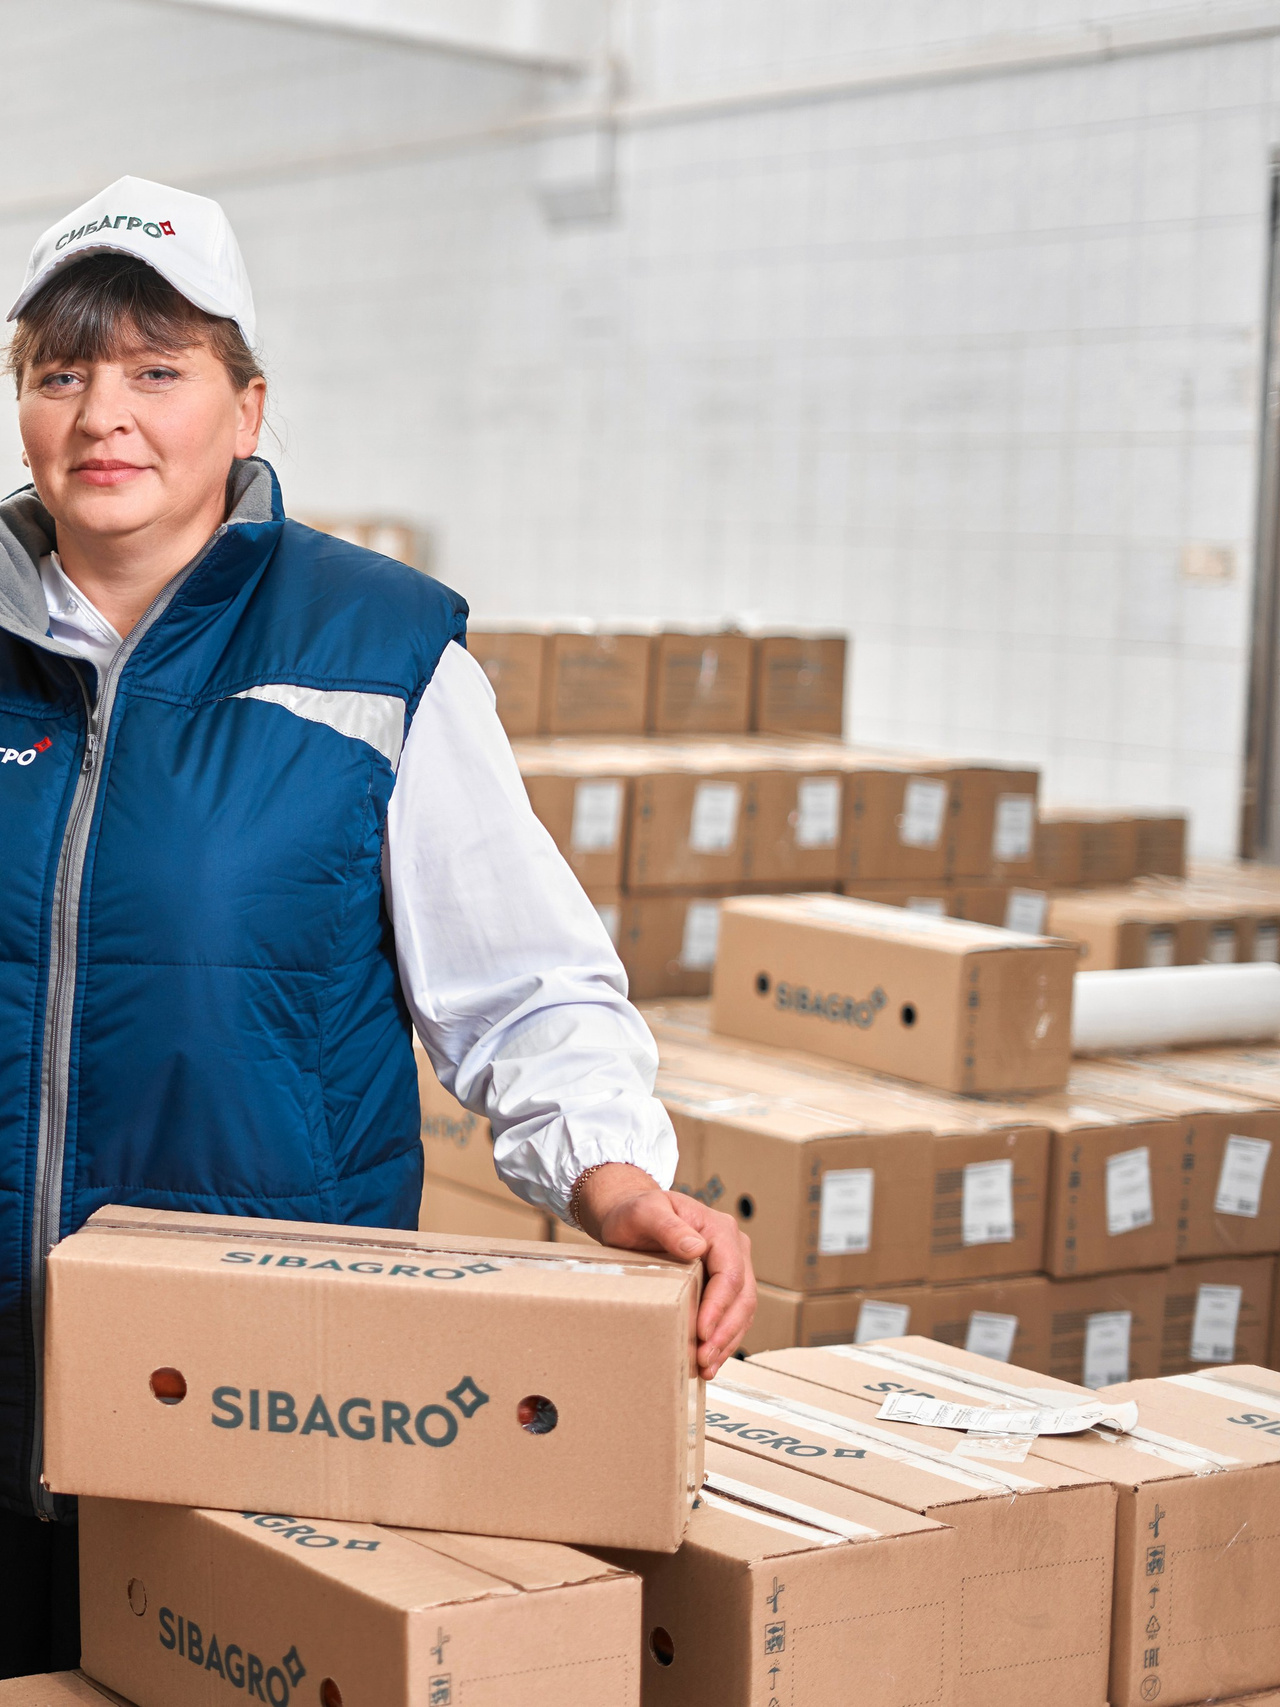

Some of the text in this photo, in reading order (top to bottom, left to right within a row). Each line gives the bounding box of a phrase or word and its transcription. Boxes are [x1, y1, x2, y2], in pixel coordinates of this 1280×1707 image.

[55, 215, 163, 250] СИБАГРО
[220, 1251, 466, 1280] SIBAGRO
[211, 1385, 459, 1448] SIBAGRO
[705, 1409, 827, 1457] BAGRO
[158, 1606, 290, 1707] SIBAGRO
[1144, 1647, 1160, 1669] EAC
